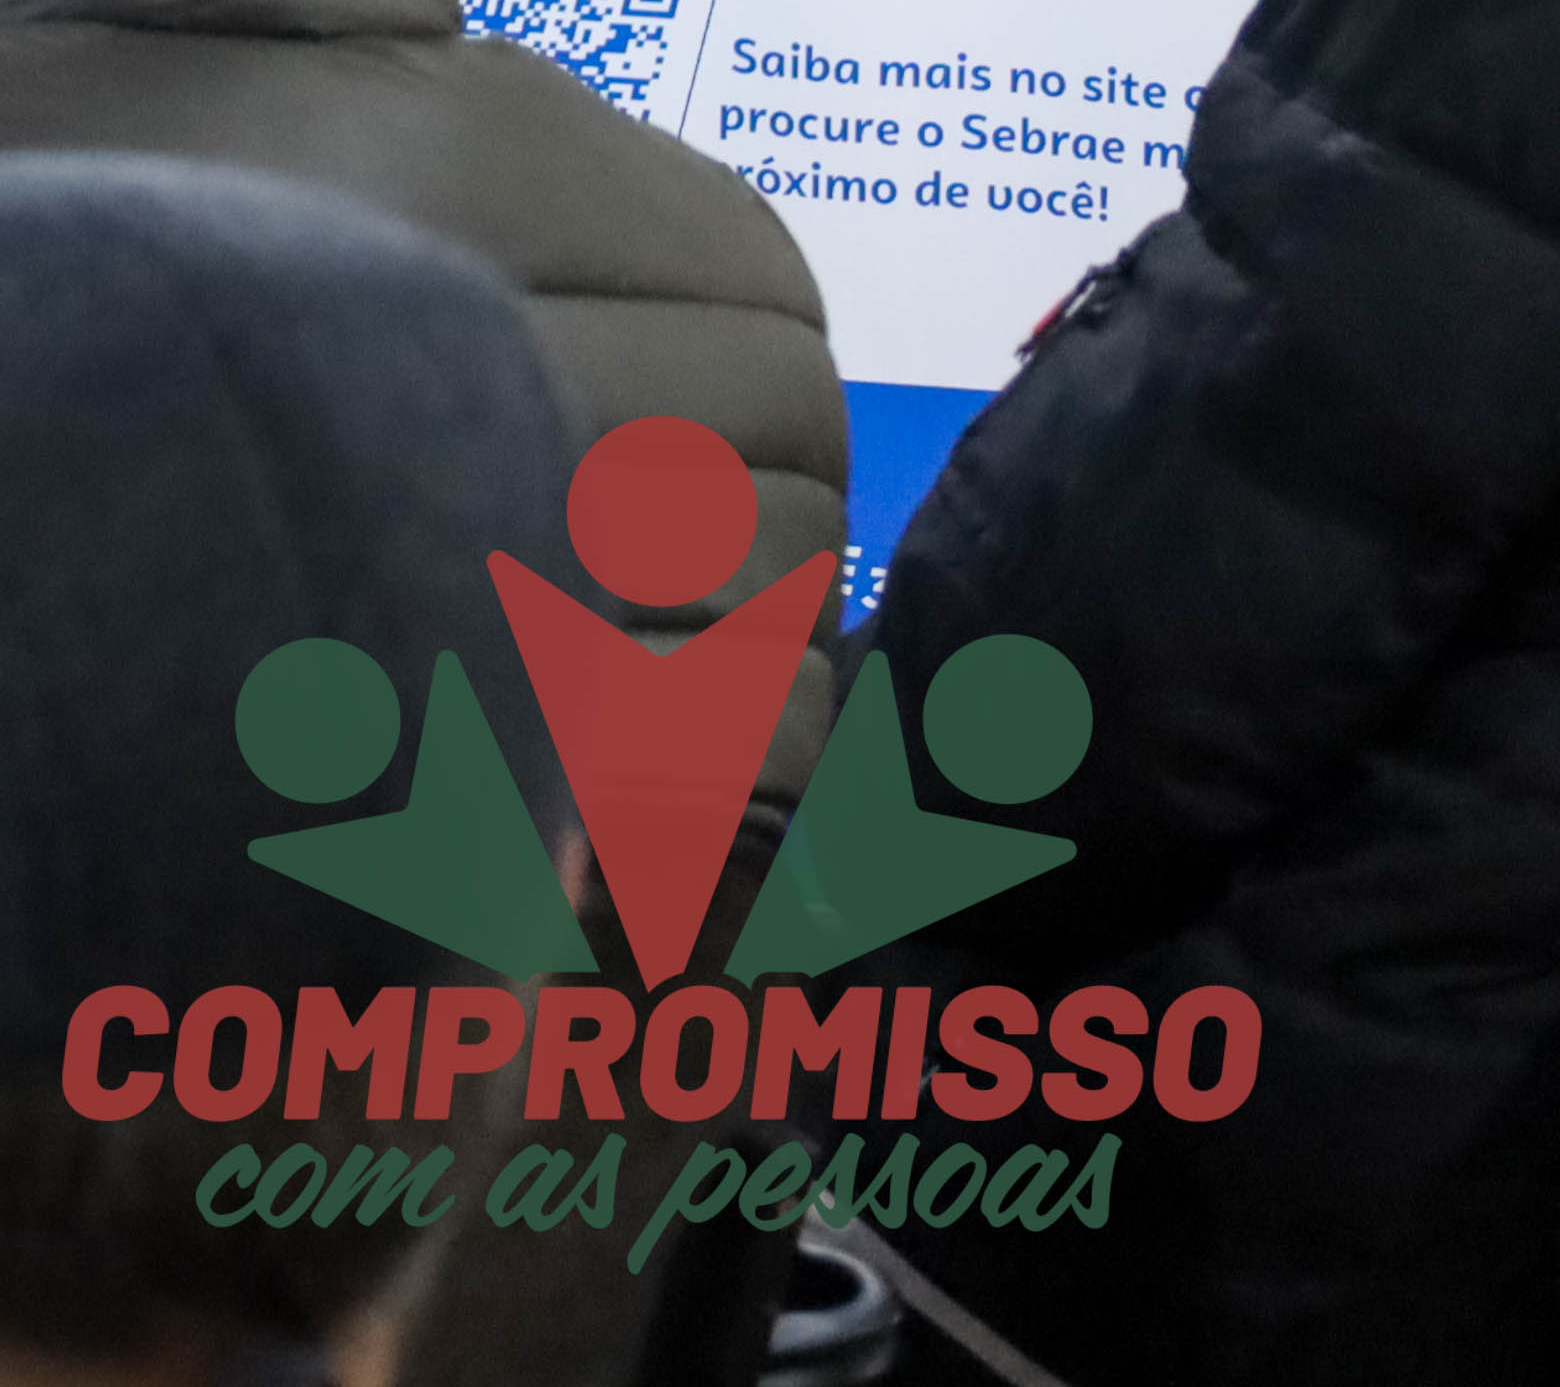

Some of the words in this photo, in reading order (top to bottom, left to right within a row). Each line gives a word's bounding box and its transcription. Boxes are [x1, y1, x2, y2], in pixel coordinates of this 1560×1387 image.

[732, 37, 860, 85] Saiba
[879, 53, 992, 92] mais
[1010, 68, 1066, 98] no
[1083, 66, 1167, 109] site
[720, 105, 900, 146] procure
[917, 121, 944, 148] o
[961, 114, 1125, 164] Sebrae
[734, 156, 897, 205] róximo
[915, 170, 969, 209] de
[988, 181, 1108, 222] você!
